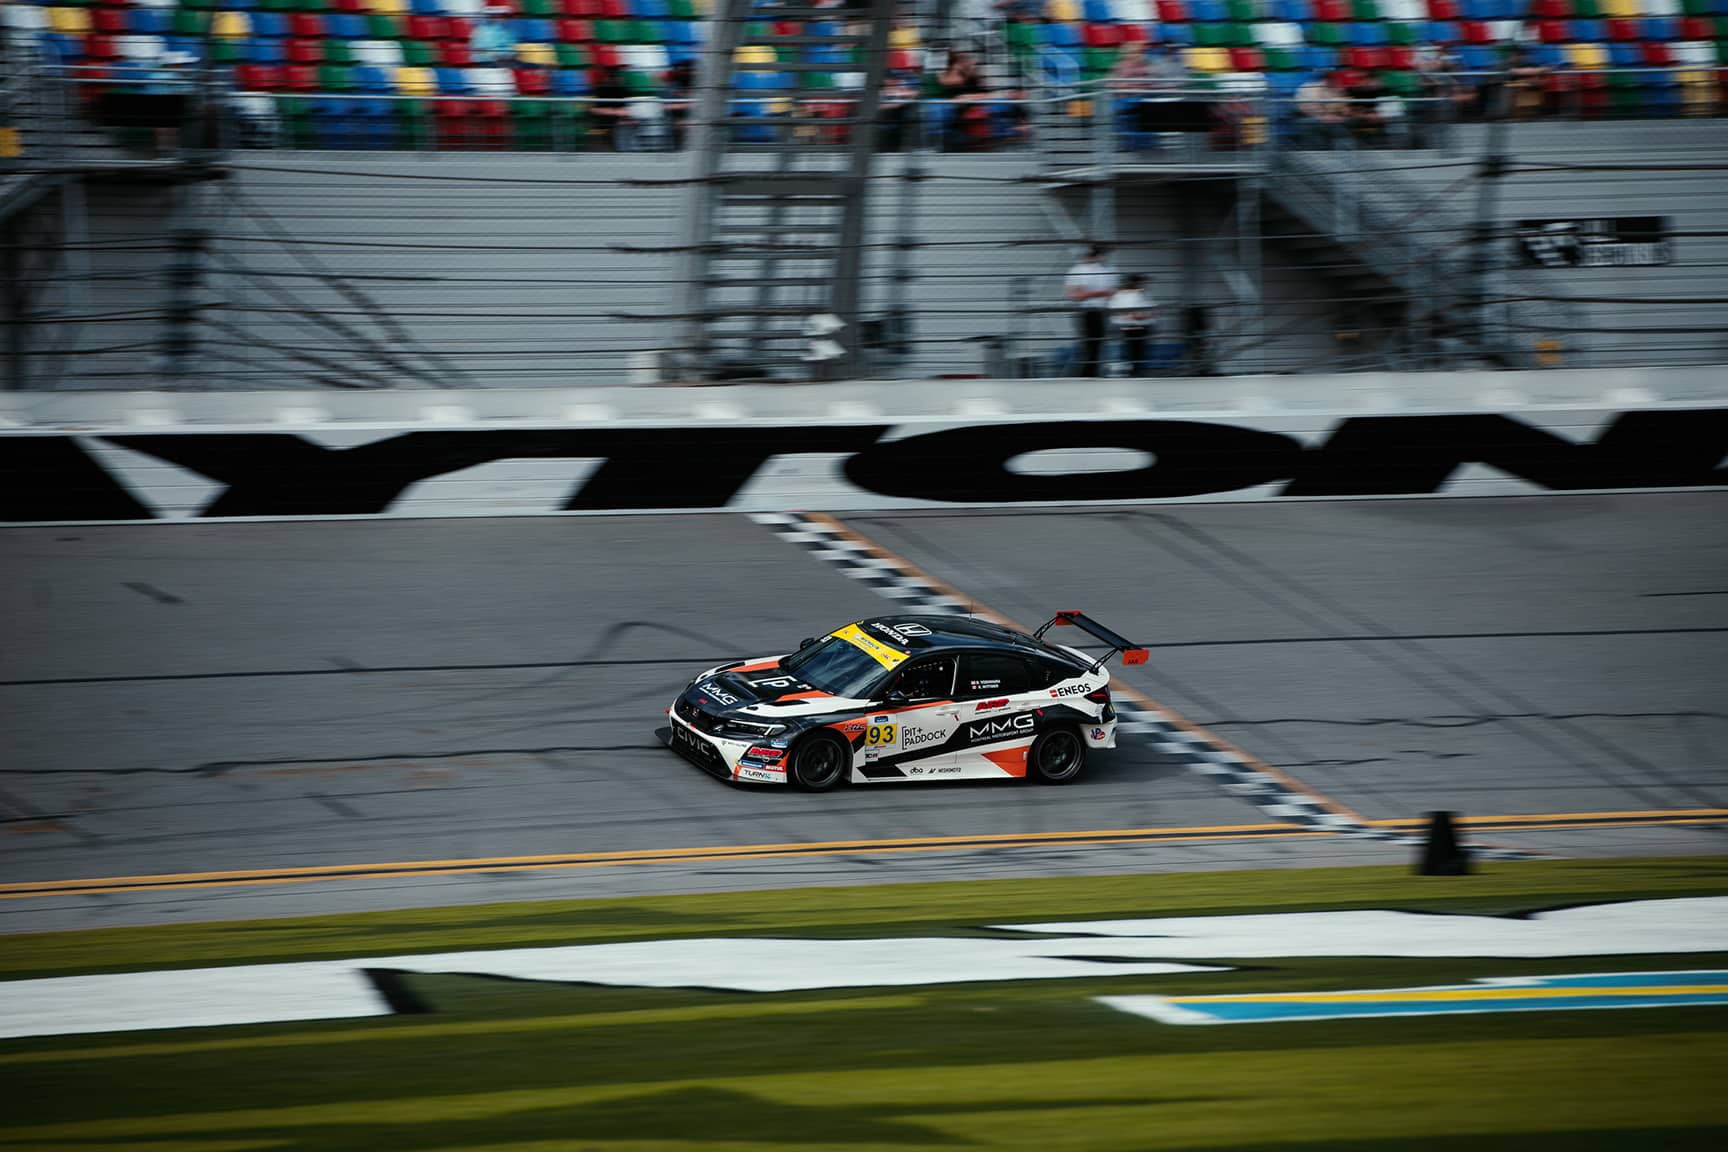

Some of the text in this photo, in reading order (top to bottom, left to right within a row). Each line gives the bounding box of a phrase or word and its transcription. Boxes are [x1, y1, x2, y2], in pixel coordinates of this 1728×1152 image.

[0, 409, 1728, 522] YTON
[871, 622, 909, 645] HONDA
[702, 683, 738, 705] MMG
[1058, 683, 1091, 697] ENEOS
[869, 726, 893, 744] 93
[970, 714, 1034, 738] MMG
[677, 726, 709, 756] CIVIC
[905, 729, 946, 746] PADDOCK
